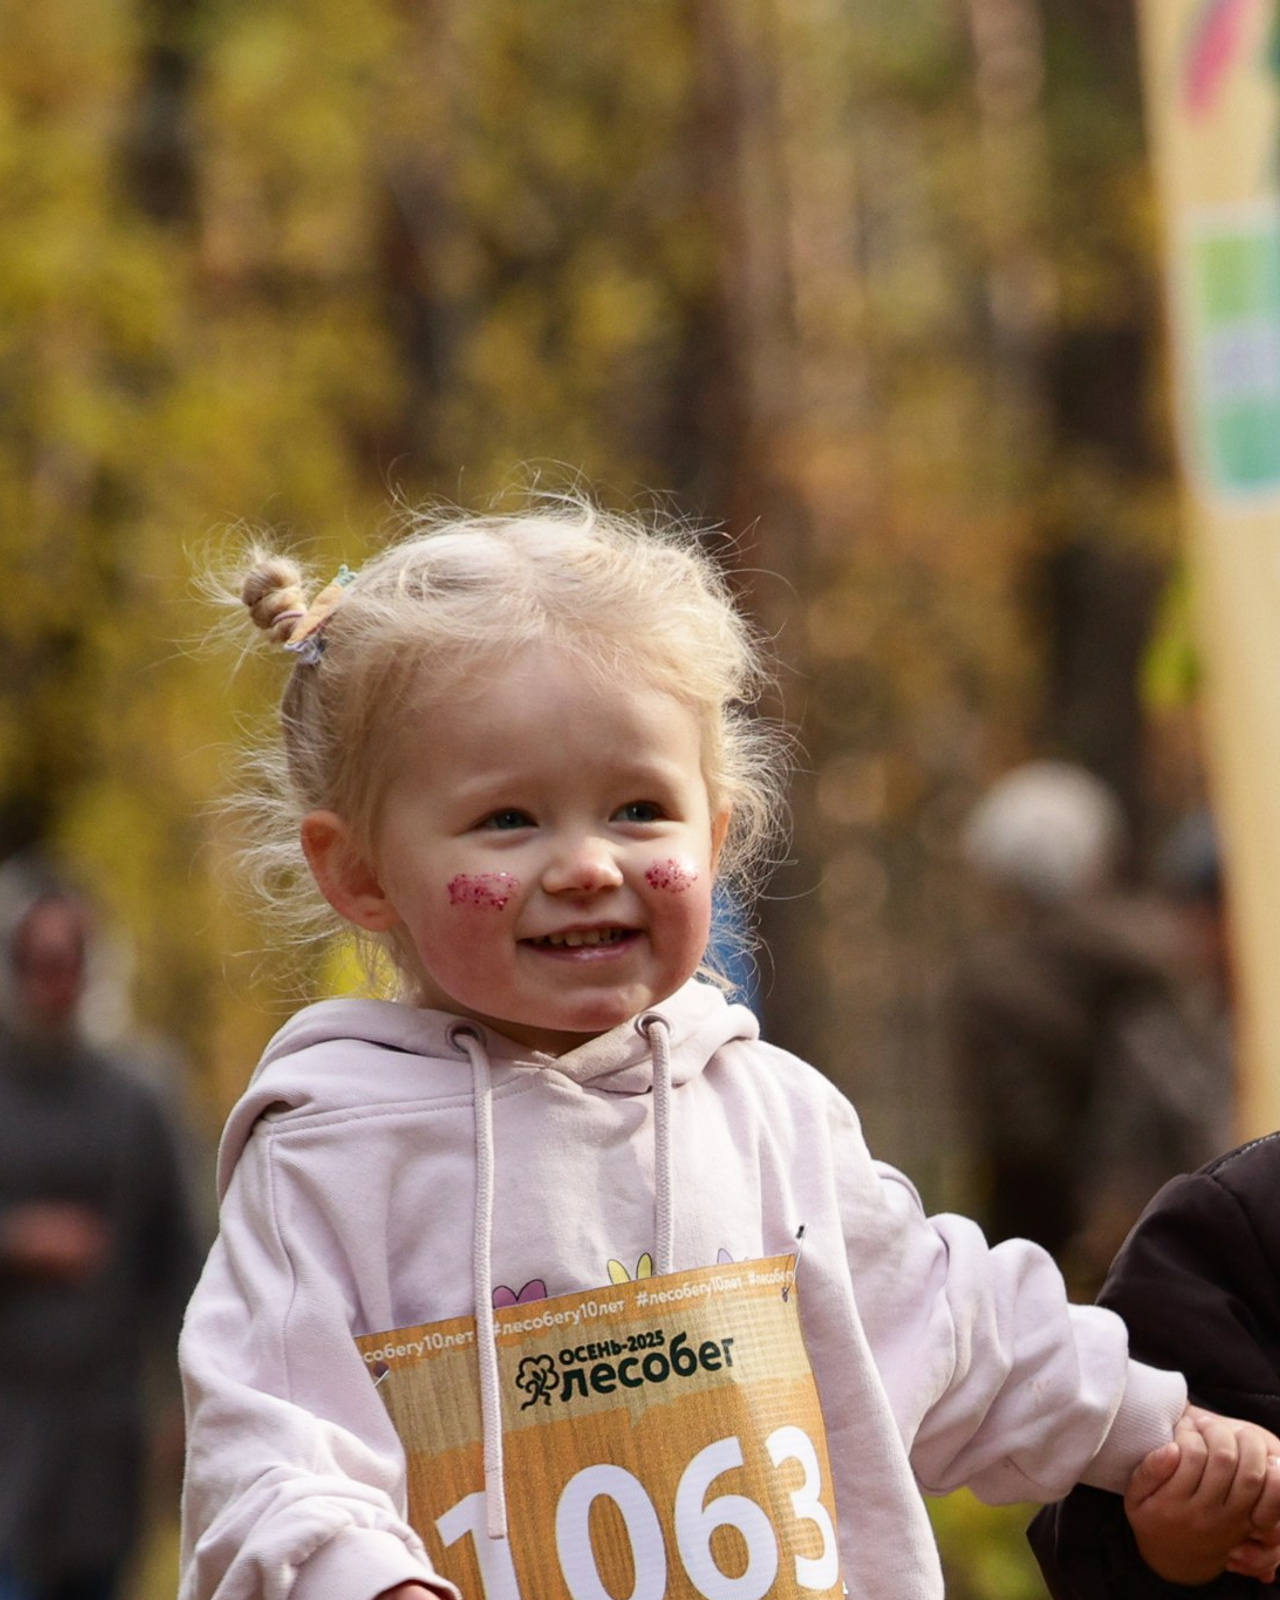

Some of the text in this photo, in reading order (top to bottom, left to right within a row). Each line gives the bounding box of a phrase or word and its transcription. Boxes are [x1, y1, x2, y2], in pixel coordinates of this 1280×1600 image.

[636, 1272, 744, 1308] #лесобегу10лет
[558, 1328, 666, 1367] ОСЕНЬ-2025
[560, 1331, 735, 1403] лесобег
